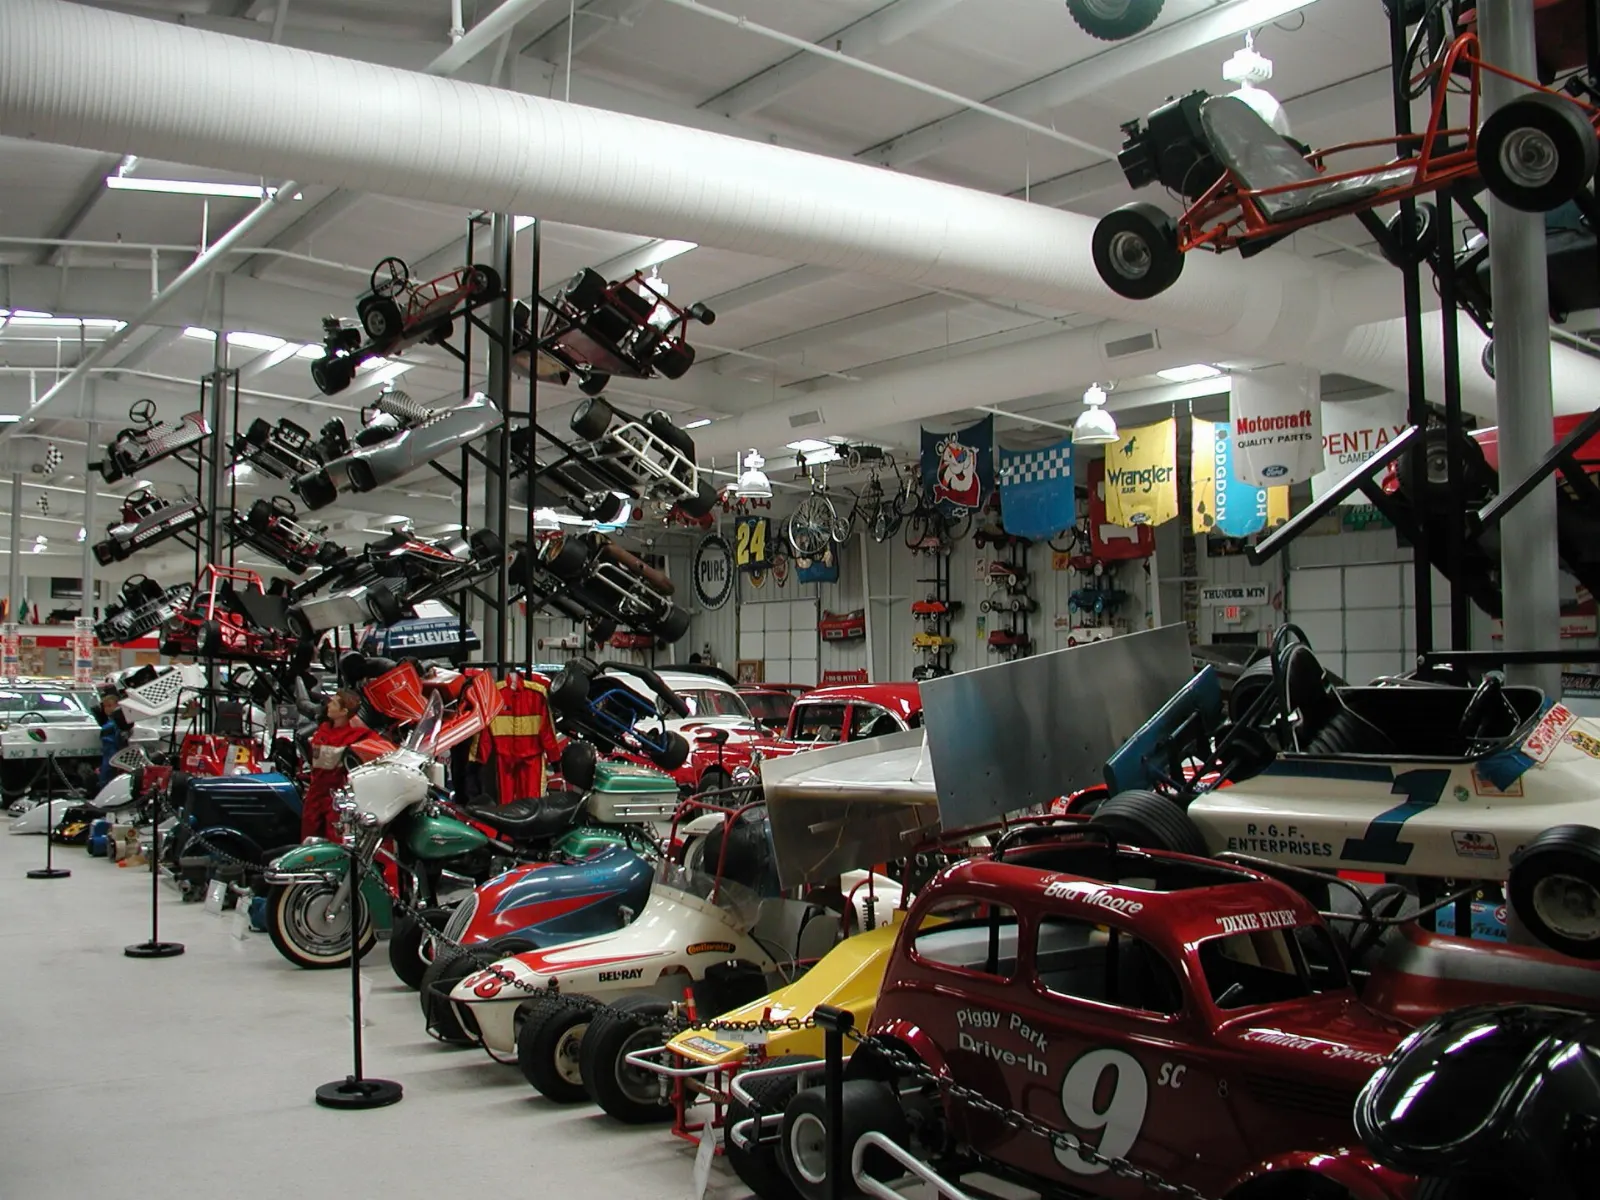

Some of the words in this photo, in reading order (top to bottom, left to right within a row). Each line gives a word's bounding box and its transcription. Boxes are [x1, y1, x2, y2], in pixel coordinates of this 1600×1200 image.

[1237, 410, 1312, 435] Motorcraft
[1238, 436, 1274, 448] QUALITY
[1278, 432, 1312, 443] PARTS
[1107, 464, 1173, 493] Wrangler
[737, 520, 767, 566] 24
[700, 560, 725, 582] PURE
[1203, 588, 1244, 600] THUNDER
[1246, 587, 1266, 598] MTN
[1340, 769, 1451, 866] 1
[1227, 836, 1333, 857] ENTERPRISES
[1081, 888, 1144, 914] Moore
[956, 1008, 1001, 1028] Piggy
[1009, 1013, 1049, 1053] Park
[958, 1031, 1049, 1076] Drive-In
[1157, 1062, 1187, 1089] SC
[1053, 1048, 1148, 1175] 9
